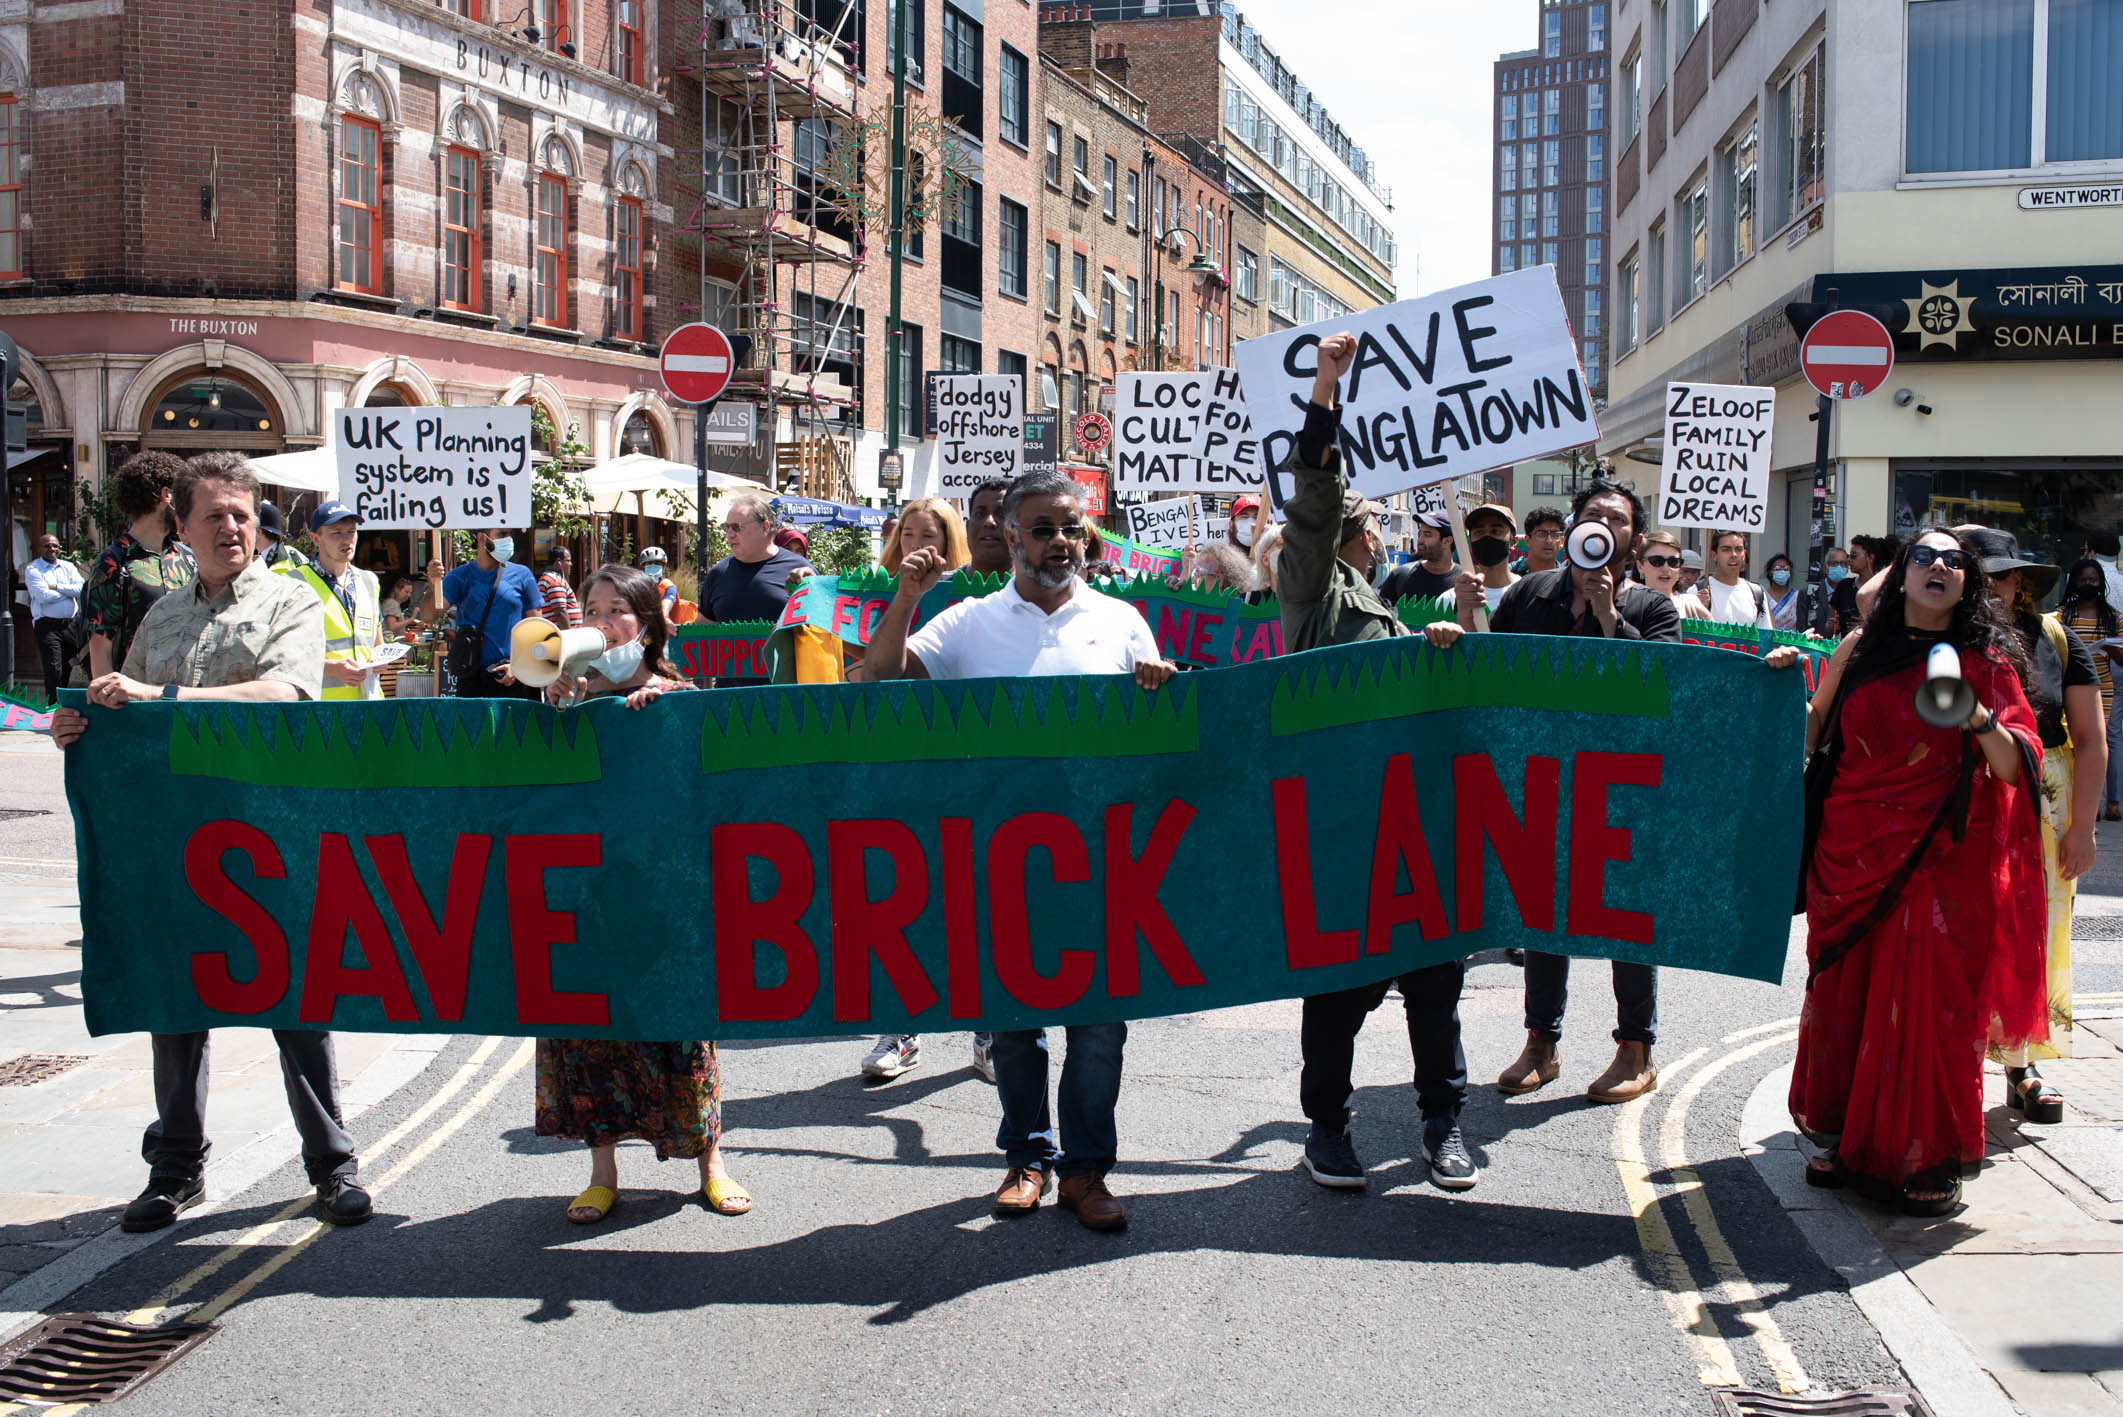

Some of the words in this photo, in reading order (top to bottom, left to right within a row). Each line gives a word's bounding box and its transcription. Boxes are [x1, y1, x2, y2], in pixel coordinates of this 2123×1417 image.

[457, 39, 568, 106] BUXTON
[1995, 275, 2088, 307] সোনালী
[169, 318, 197, 333] THE
[200, 320, 258, 335] BUXTON
[1994, 324, 2097, 348] SONALI
[1283, 295, 1513, 413] SAVE
[1134, 379, 1202, 409] LOC
[1668, 387, 1772, 422] ZELOOF
[706, 411, 749, 427] AILS
[939, 410, 1020, 439] offshore
[1077, 416, 1096, 447] PICCOLO
[344, 415, 403, 450] UK
[416, 417, 526, 476] Planning
[1262, 368, 1587, 511] BNGLATOWN
[1672, 422, 1767, 452] FAMILY
[944, 441, 1015, 472] Jersey
[1023, 461, 1055, 471] ercial
[1677, 448, 1748, 472] RUIN
[355, 454, 453, 495] system
[467, 457, 490, 487] is
[1670, 473, 1757, 499] LOCAL
[356, 489, 446, 528] failing
[463, 484, 507, 524] us!
[1664, 496, 1763, 526] DREAMS
[1102, 542, 1122, 565] OR
[1128, 551, 1182, 577] BRICK
[681, 638, 767, 677] SUPPO
[3, 704, 54, 728] FO
[184, 819, 610, 1025] SAVE
[711, 797, 1207, 1022] BRICK
[1271, 751, 1663, 970] LANE
